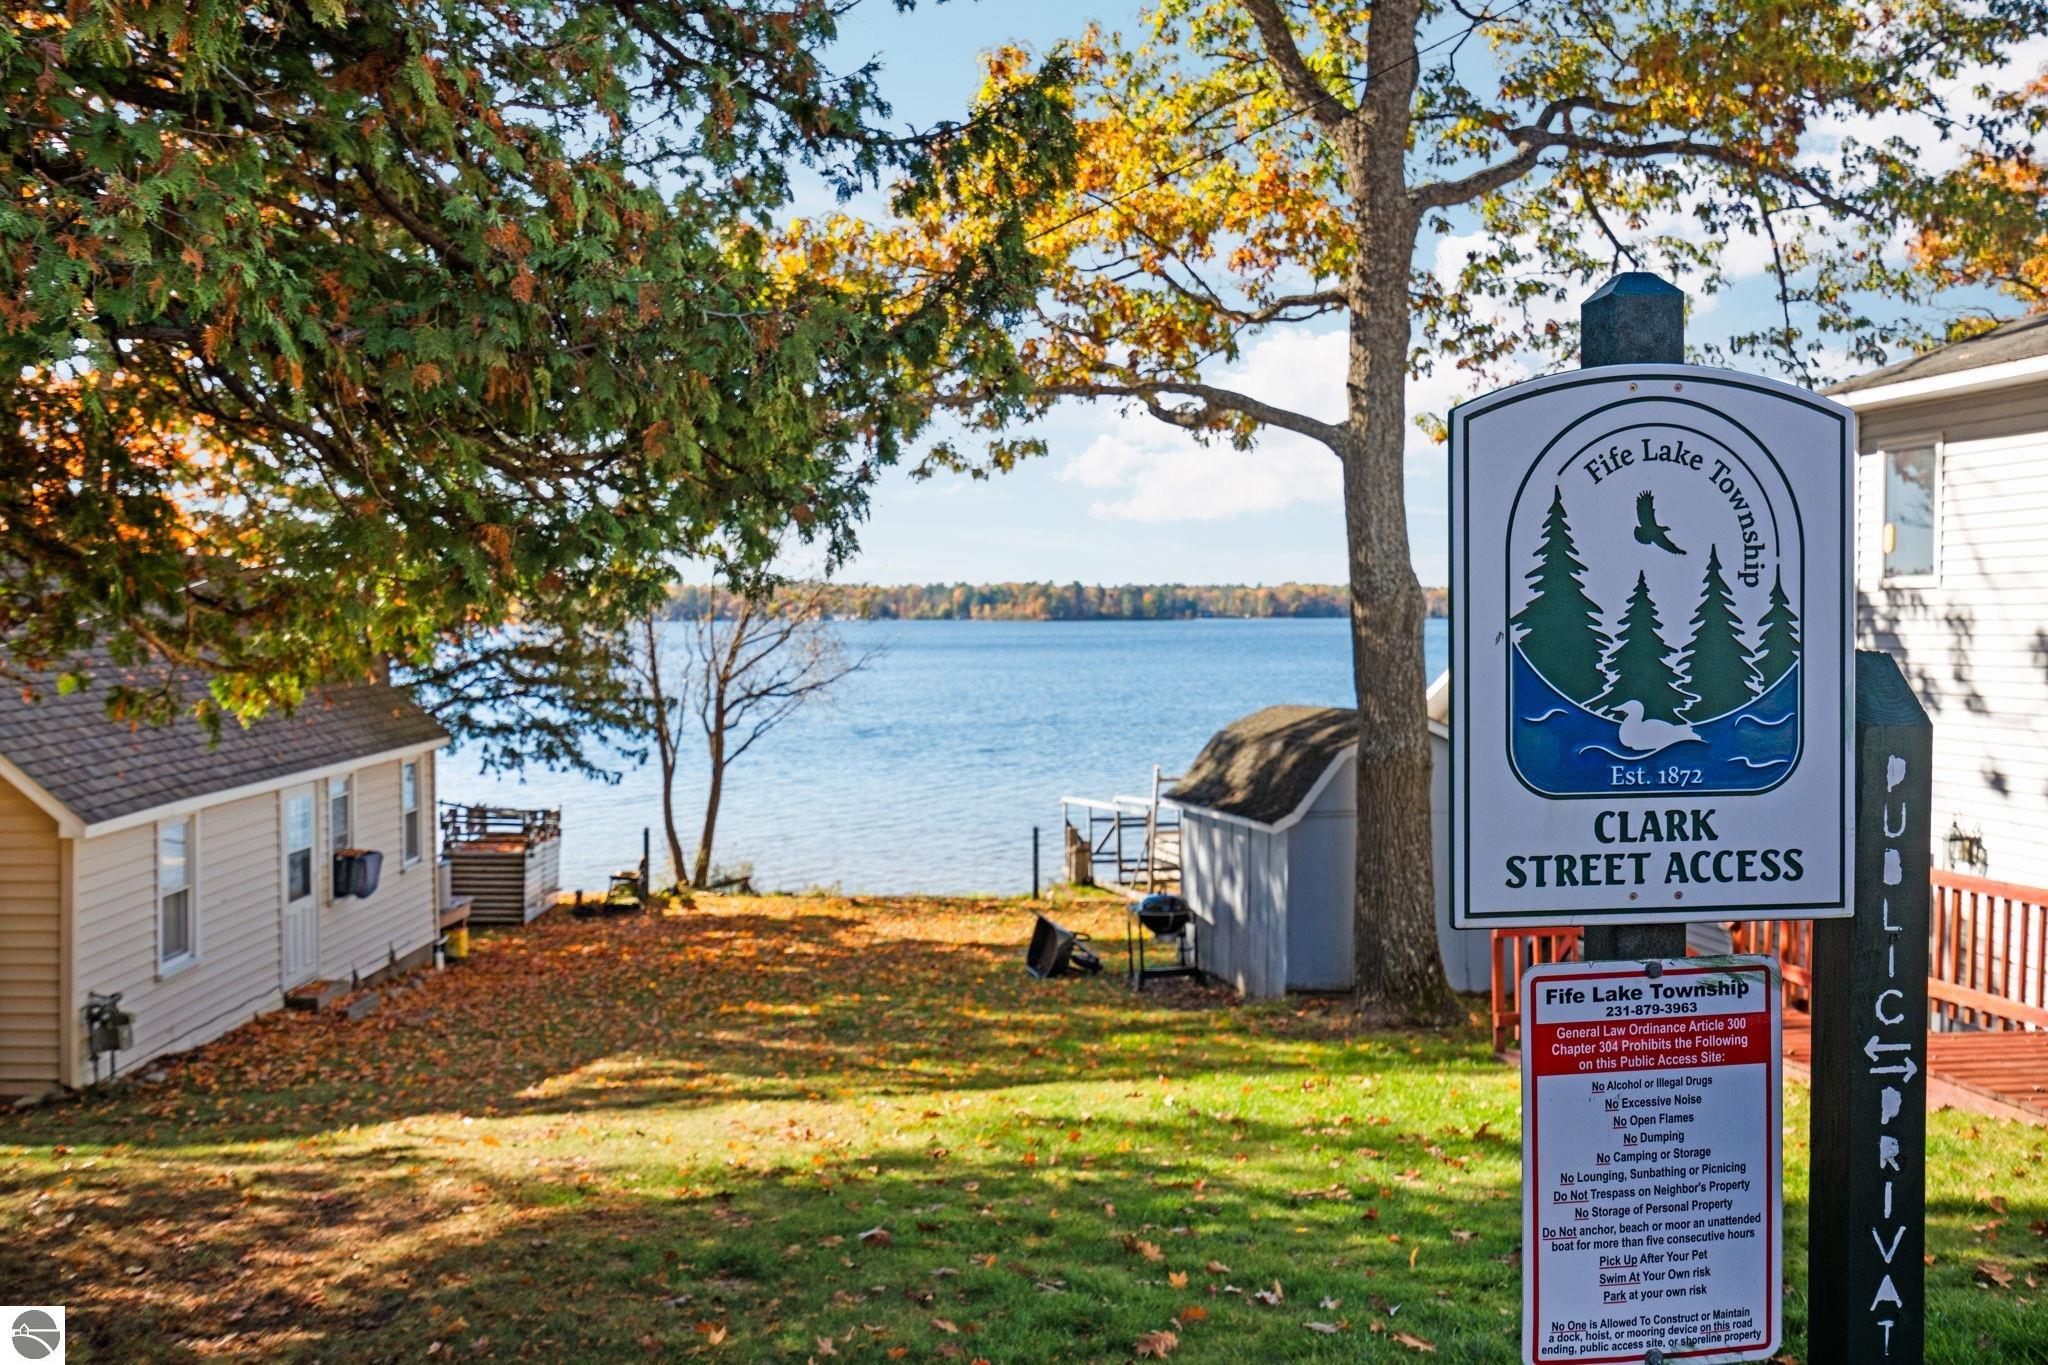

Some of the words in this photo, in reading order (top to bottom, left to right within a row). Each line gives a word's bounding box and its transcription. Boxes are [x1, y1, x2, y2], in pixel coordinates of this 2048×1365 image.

[1583, 444, 1636, 485] Fife
[1641, 439, 1705, 472] Lake
[1708, 459, 1766, 589] Township
[1611, 766, 1651, 785] Est.
[1659, 767, 1703, 785] 1872
[1595, 809, 1718, 843] CLARK
[1505, 852, 1650, 888] STREET
[1665, 848, 1804, 885] ACCESS
[1875, 754, 1906, 1025] PUBLIC
[1546, 988, 1585, 1005] Fife
[1593, 985, 1643, 1003] Lake
[1650, 980, 1749, 999] Township
[1606, 1003, 1697, 1017] 231-879-3963
[1557, 1025, 1600, 1039] General
[1603, 1025, 1626, 1037] Law
[1629, 1022, 1686, 1036] Ordinance
[1689, 1019, 1724, 1032] Article
[1727, 1018, 1746, 1029] 300
[1552, 1042, 1596, 1057] Chapter
[1599, 1041, 1618, 1053] 304
[1622, 1038, 1671, 1051] Prohibits
[1675, 1037, 1692, 1049] the
[1696, 1034, 1748, 1049] Following
[1579, 1060, 1592, 1070] on
[1596, 1057, 1616, 1069] this
[1620, 1054, 1654, 1067] Public
[1658, 1053, 1697, 1065] Access
[1701, 1051, 1725, 1063] Site:
[1592, 1082, 1604, 1092] No
[1607, 1079, 1642, 1090] Alcohol
[1645, 1080, 1654, 1088] or
[1656, 1077, 1683, 1090] Illegal
[1686, 1076, 1712, 1088] Drugs
[1605, 1099, 1619, 1110] No
[1622, 1096, 1671, 1108] Excessive
[1674, 1094, 1702, 1105] Noise
[1613, 1117, 1627, 1127] No
[1630, 1116, 1656, 1128] Open
[1659, 1113, 1694, 1124] Flames
[1624, 1134, 1637, 1144] No
[1640, 1130, 1684, 1144] Dumping
[1597, 1152, 1610, 1164] No
[1613, 1150, 1658, 1164] Camping
[1661, 1149, 1671, 1160] or
[1674, 1147, 1711, 1160] Storage
[1560, 1173, 1574, 1184] No
[1577, 1169, 1627, 1184] Lounging,
[1630, 1166, 1686, 1182] Sunbathing
[1689, 1165, 1699, 1175] or
[1702, 1162, 1746, 1175] Picnicing
[1553, 1191, 1568, 1202] Do
[1571, 1189, 1588, 1201] Not
[1590, 1187, 1635, 1201] Trespass
[1638, 1186, 1651, 1196] on
[1654, 1183, 1706, 1197] Neighbor's
[1709, 1180, 1750, 1193] Property
[1575, 1208, 1589, 1218] No
[1592, 1205, 1630, 1218] Storage
[1633, 1204, 1644, 1215] of
[1646, 1201, 1689, 1213] Personal
[1692, 1199, 1733, 1212] Property
[1543, 1227, 1556, 1238] Do
[1559, 1225, 1577, 1237] Not
[1579, 1224, 1616, 1237] anchor,
[1620, 1221, 1649, 1233] beach
[1652, 1221, 1662, 1231] or
[1665, 1220, 1690, 1230] moor
[1693, 1218, 1705, 1227] an
[1708, 1213, 1761, 1227] unattended
[1552, 1240, 1574, 1251] boat
[1577, 1239, 1591, 1250] for
[1594, 1239, 1619, 1249] more
[1622, 1236, 1643, 1248] than
[1646, 1234, 1664, 1246] five
[1667, 1231, 1724, 1245] consecutive
[1727, 1228, 1755, 1239] hours
[1600, 1255, 1621, 1267] Pick
[1624, 1255, 1637, 1267] Up
[1640, 1252, 1663, 1264] After
[1667, 1251, 1689, 1262] Your
[1692, 1249, 1708, 1260] Pet
[1599, 1273, 1626, 1284] Swim
[1629, 1271, 1640, 1282] At
[1643, 1270, 1665, 1281] Your
[1668, 1269, 1690, 1279] Own
[1693, 1266, 1711, 1277] risk
[1604, 1290, 1626, 1302] Park
[1629, 1289, 1638, 1300] at
[1641, 1288, 1662, 1301] your
[1666, 1287, 1686, 1297] own
[1689, 1284, 1707, 1295] risk
[1552, 1321, 1565, 1331] No
[1568, 1320, 1587, 1330] One
[1589, 1319, 1597, 1329] is
[1600, 1317, 1637, 1328] Allowed
[1640, 1315, 1651, 1326] To
[1654, 1312, 1698, 1325] Construct
[1701, 1311, 1710, 1321] or
[1713, 1307, 1750, 1320] Maintain
[1549, 1335, 1554, 1343] a
[1557, 1331, 1582, 1343] dock,
[1585, 1330, 1612, 1342] hoist,
[1614, 1329, 1624, 1339] or
[1627, 1326, 1665, 1340] mooring
[1668, 1324, 1698, 1336] device
[1700, 1323, 1711, 1333] on
[1714, 1320, 1730, 1331] this
[1733, 1318, 1752, 1329] road
[1541, 1344, 1577, 1356] ending,
[1580, 1341, 1609, 1354] public
[1611, 1339, 1643, 1351] access
[1646, 1337, 1666, 1349] site,
[1668, 1337, 1679, 1346] or
[1681, 1333, 1721, 1346] shoreline
[1724, 1329, 1761, 1344] property
